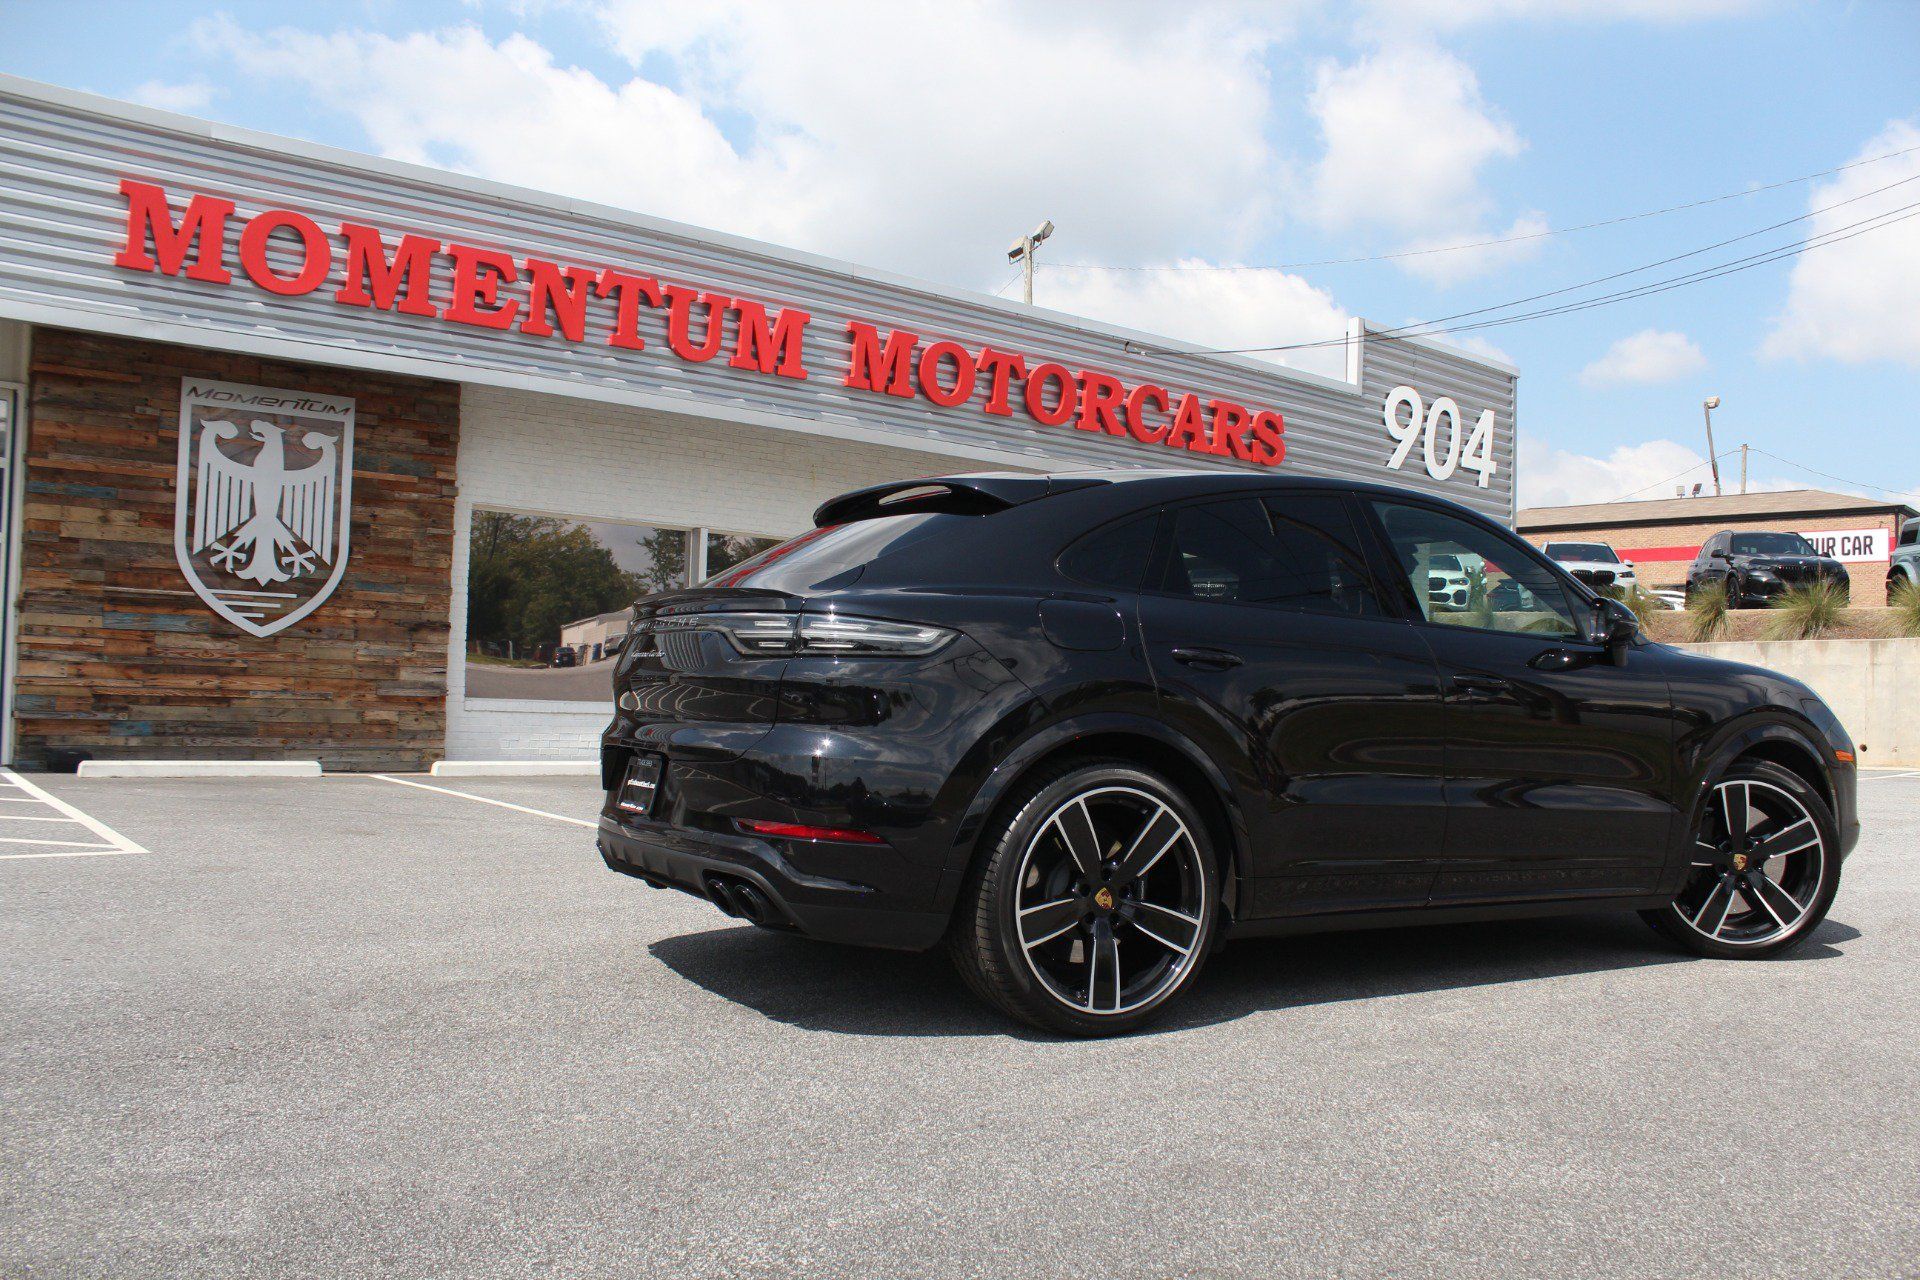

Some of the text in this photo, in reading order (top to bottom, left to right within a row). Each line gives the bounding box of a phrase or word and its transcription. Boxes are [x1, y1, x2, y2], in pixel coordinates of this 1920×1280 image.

[115, 179, 1285, 467] MOMENTUM MOTORCARS
[1384, 385, 1497, 488] 904
[1841, 535, 1873, 556] CAR
